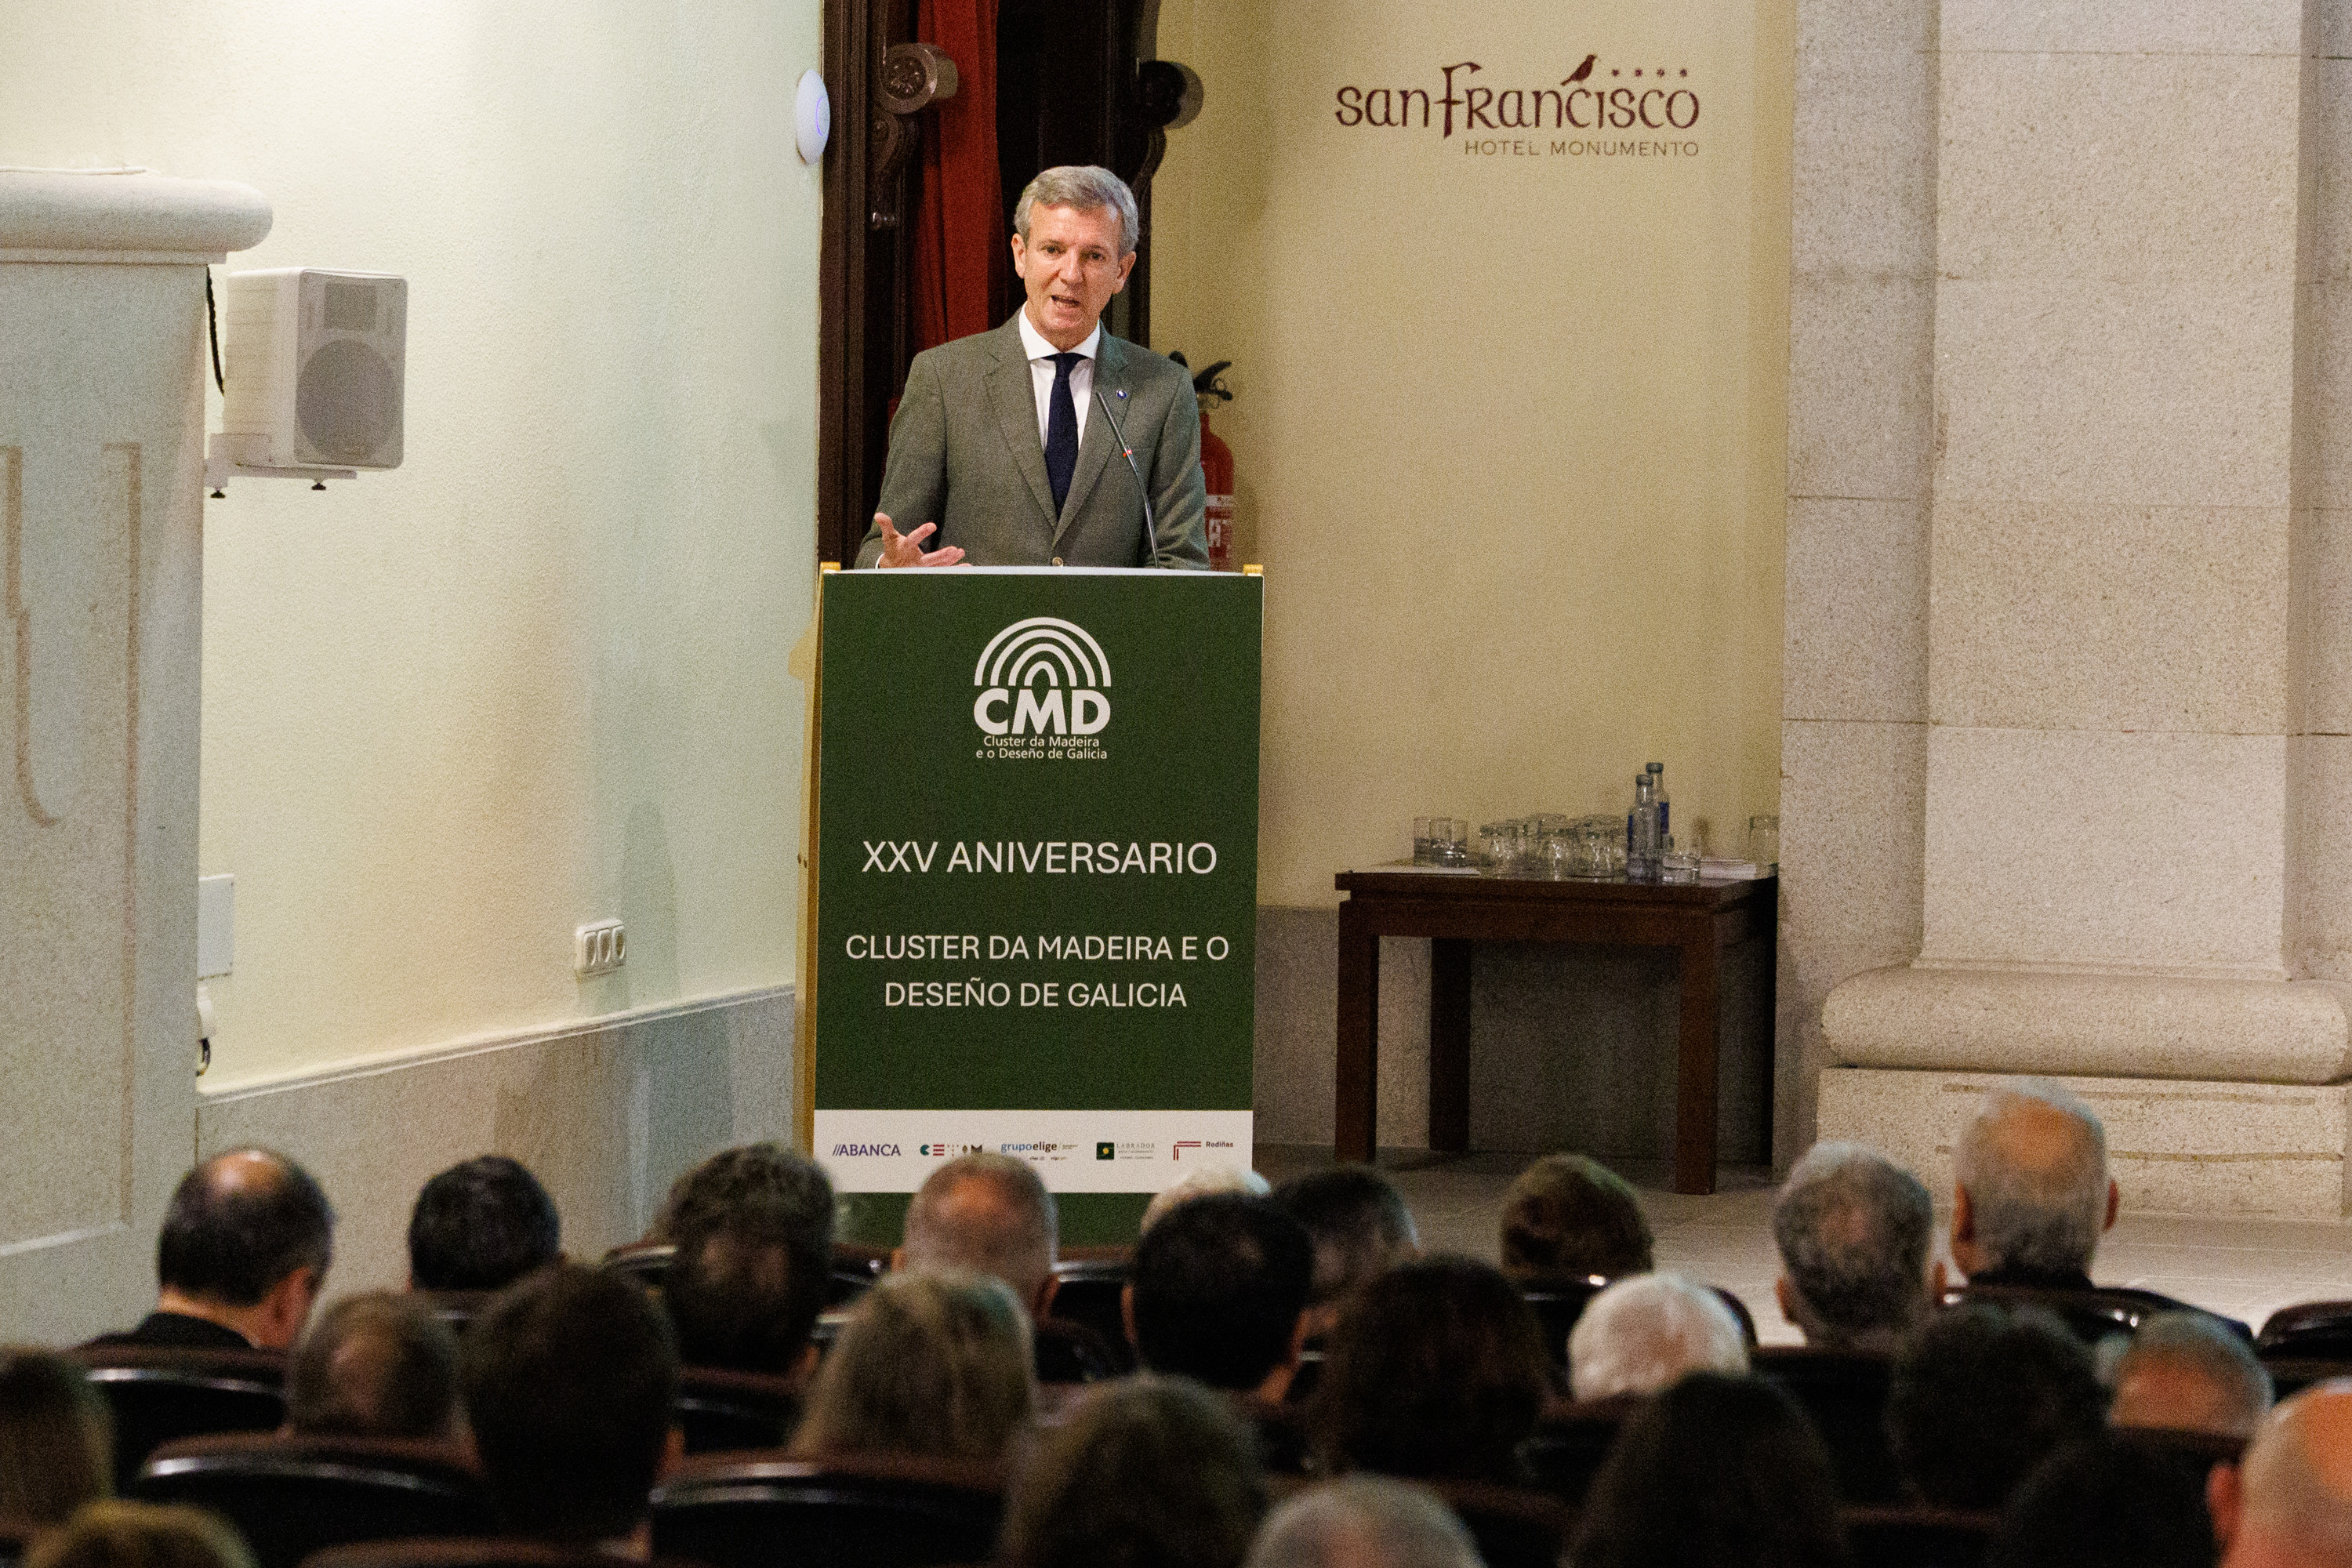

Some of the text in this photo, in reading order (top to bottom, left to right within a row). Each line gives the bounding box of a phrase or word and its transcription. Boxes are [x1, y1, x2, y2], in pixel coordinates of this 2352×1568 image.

[1465, 140, 1699, 157] HOTEL MONUMENTO
[974, 688, 1111, 735] CMD
[976, 747, 1108, 760] e o Deseño de Galicia
[983, 735, 1100, 747] Cluster da Madeira
[862, 840, 1218, 874] XXV ANIVERSARIO
[846, 935, 1229, 960] CLUSTER DA MADEIRA E O
[885, 977, 1187, 1007] DESEÑO DE GALICIA
